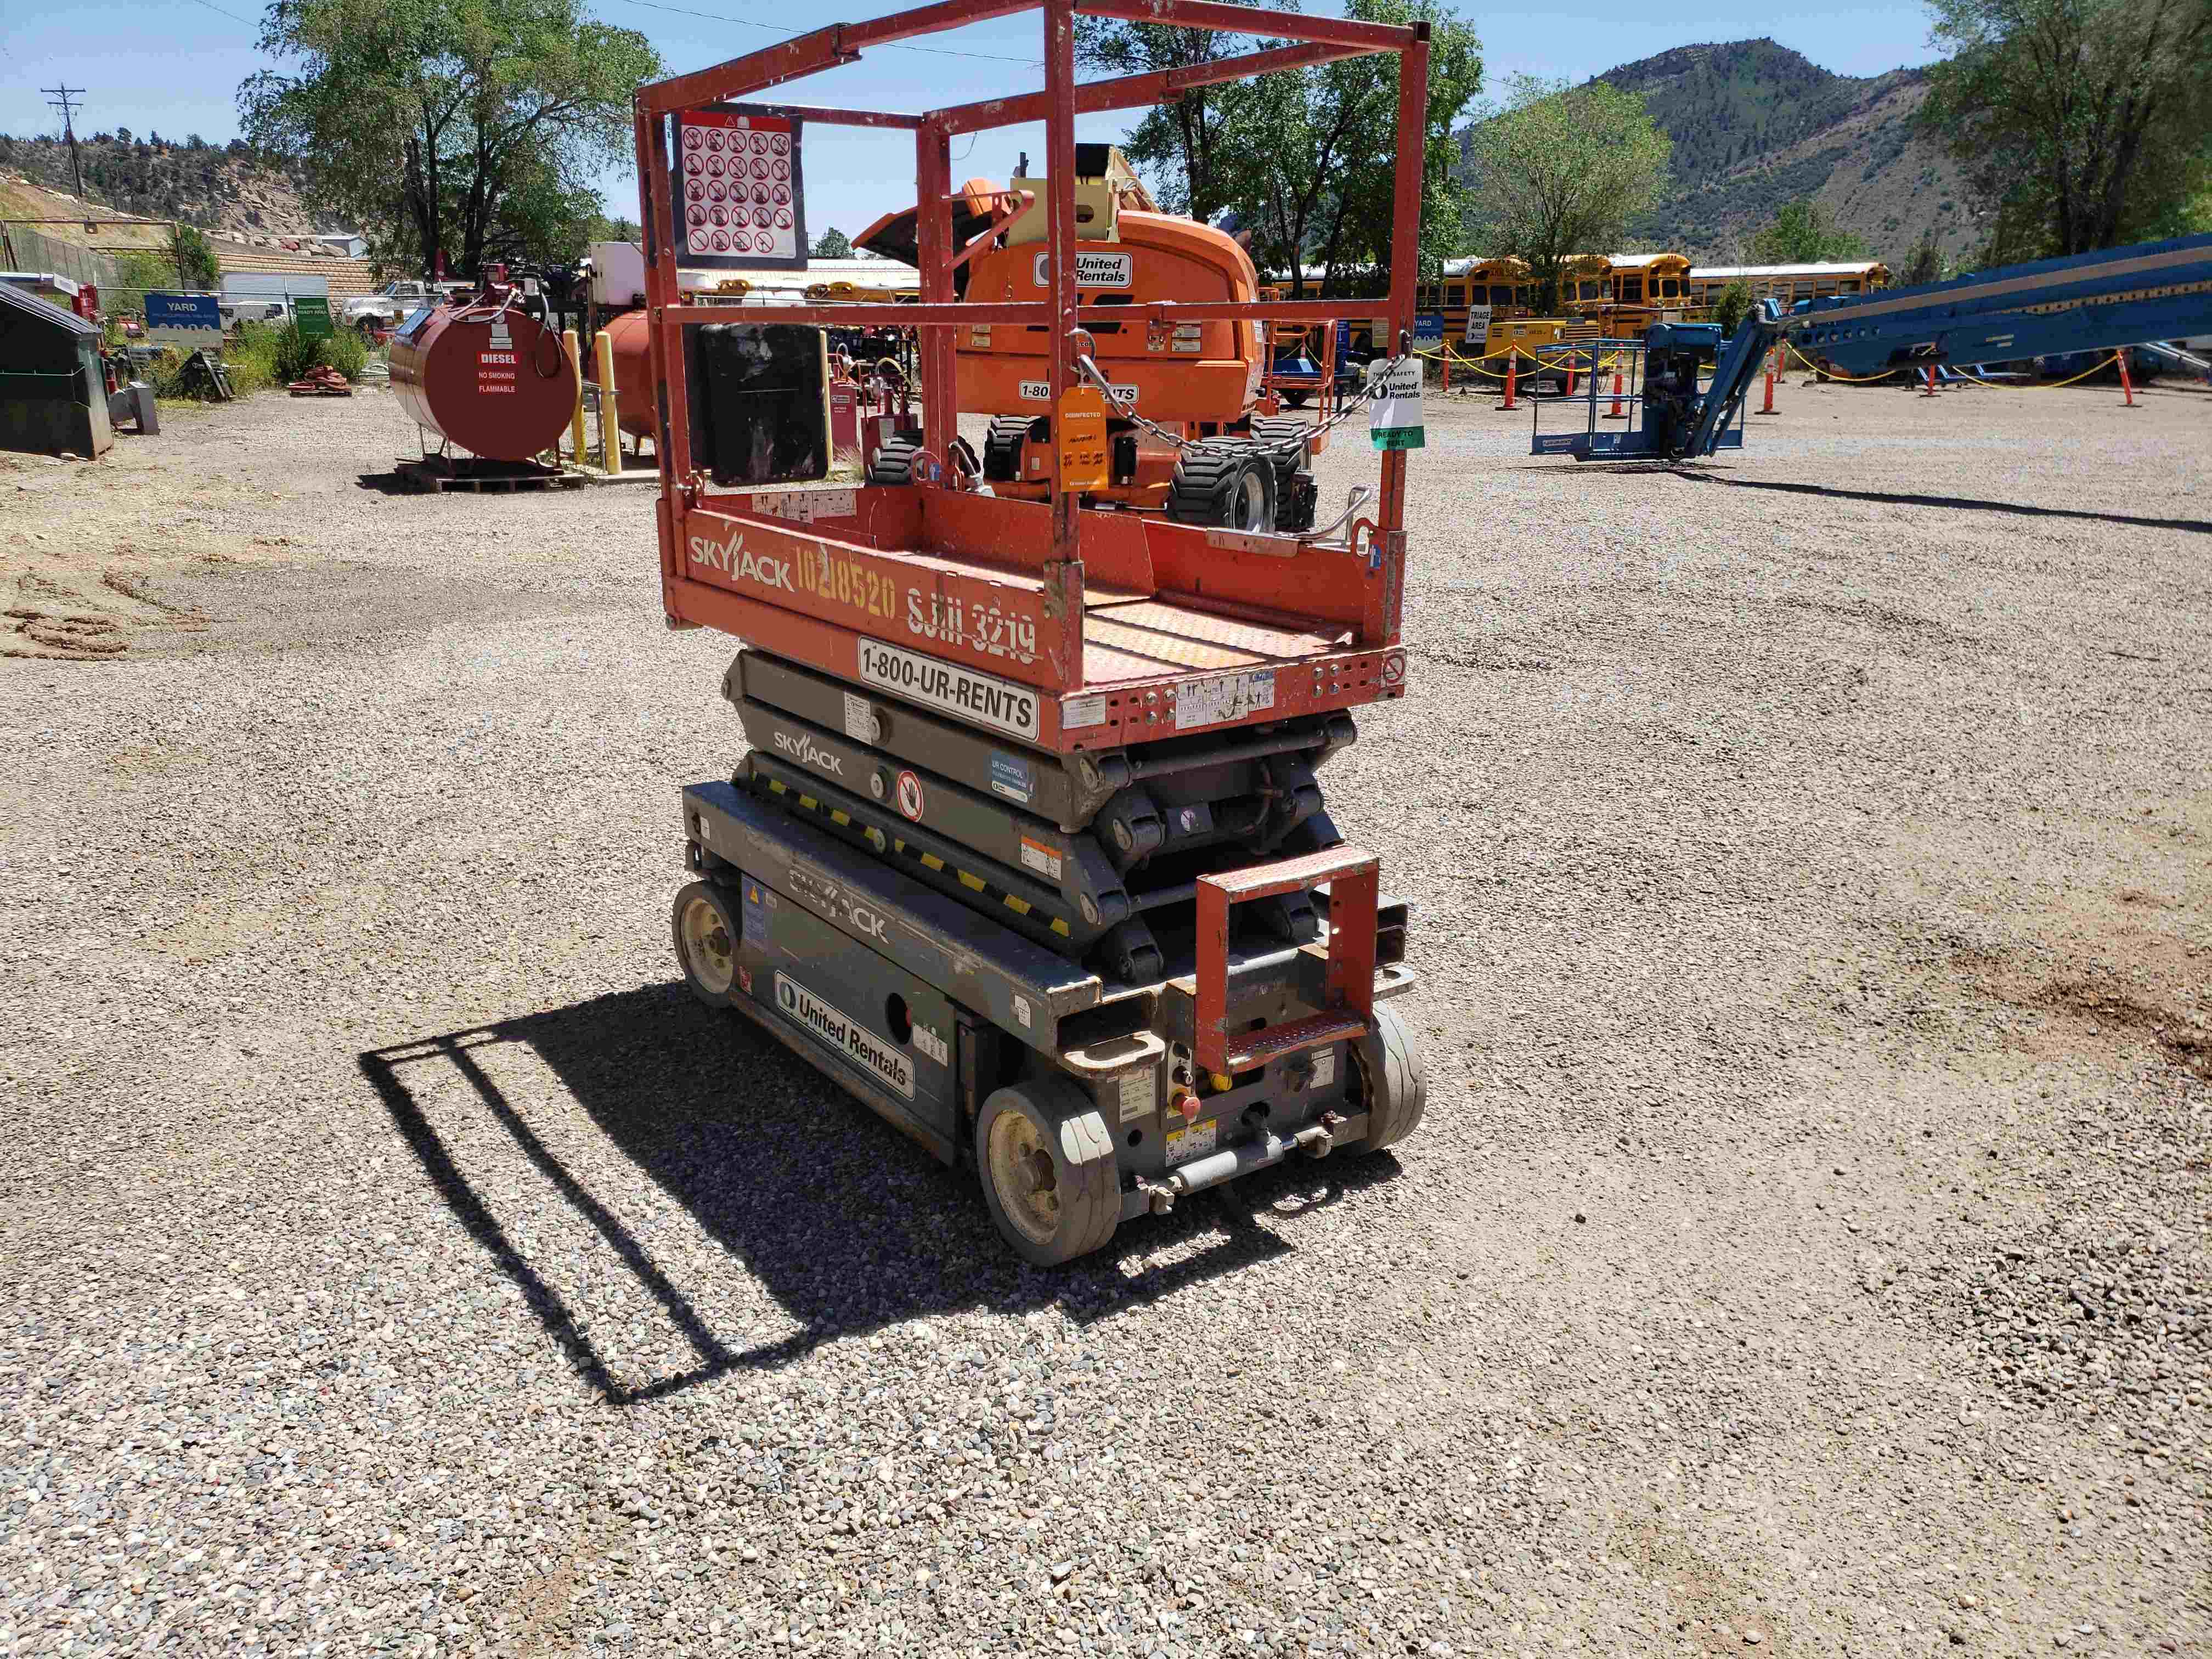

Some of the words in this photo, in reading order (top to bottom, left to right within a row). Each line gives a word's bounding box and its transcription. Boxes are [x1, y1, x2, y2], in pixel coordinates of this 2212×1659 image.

[1076, 257, 1122, 269] United
[1076, 270, 1126, 282] Rentals
[166, 302, 198, 312] YARD
[1471, 311, 1489, 319] TRIAGE
[481, 354, 516, 364] DIESEL
[1389, 382, 1418, 391] United
[1389, 391, 1421, 399] Rentals
[690, 531, 795, 592] SKYJACK
[972, 604, 1036, 664] 3219
[863, 647, 1032, 729] 1-800-UR-RENTS
[774, 731, 843, 776] SKYJACK
[992, 760, 1000, 769] UR
[1000, 763, 1023, 778] CONTROL
[799, 994, 846, 1044] United
[849, 1028, 906, 1086] Rentals
